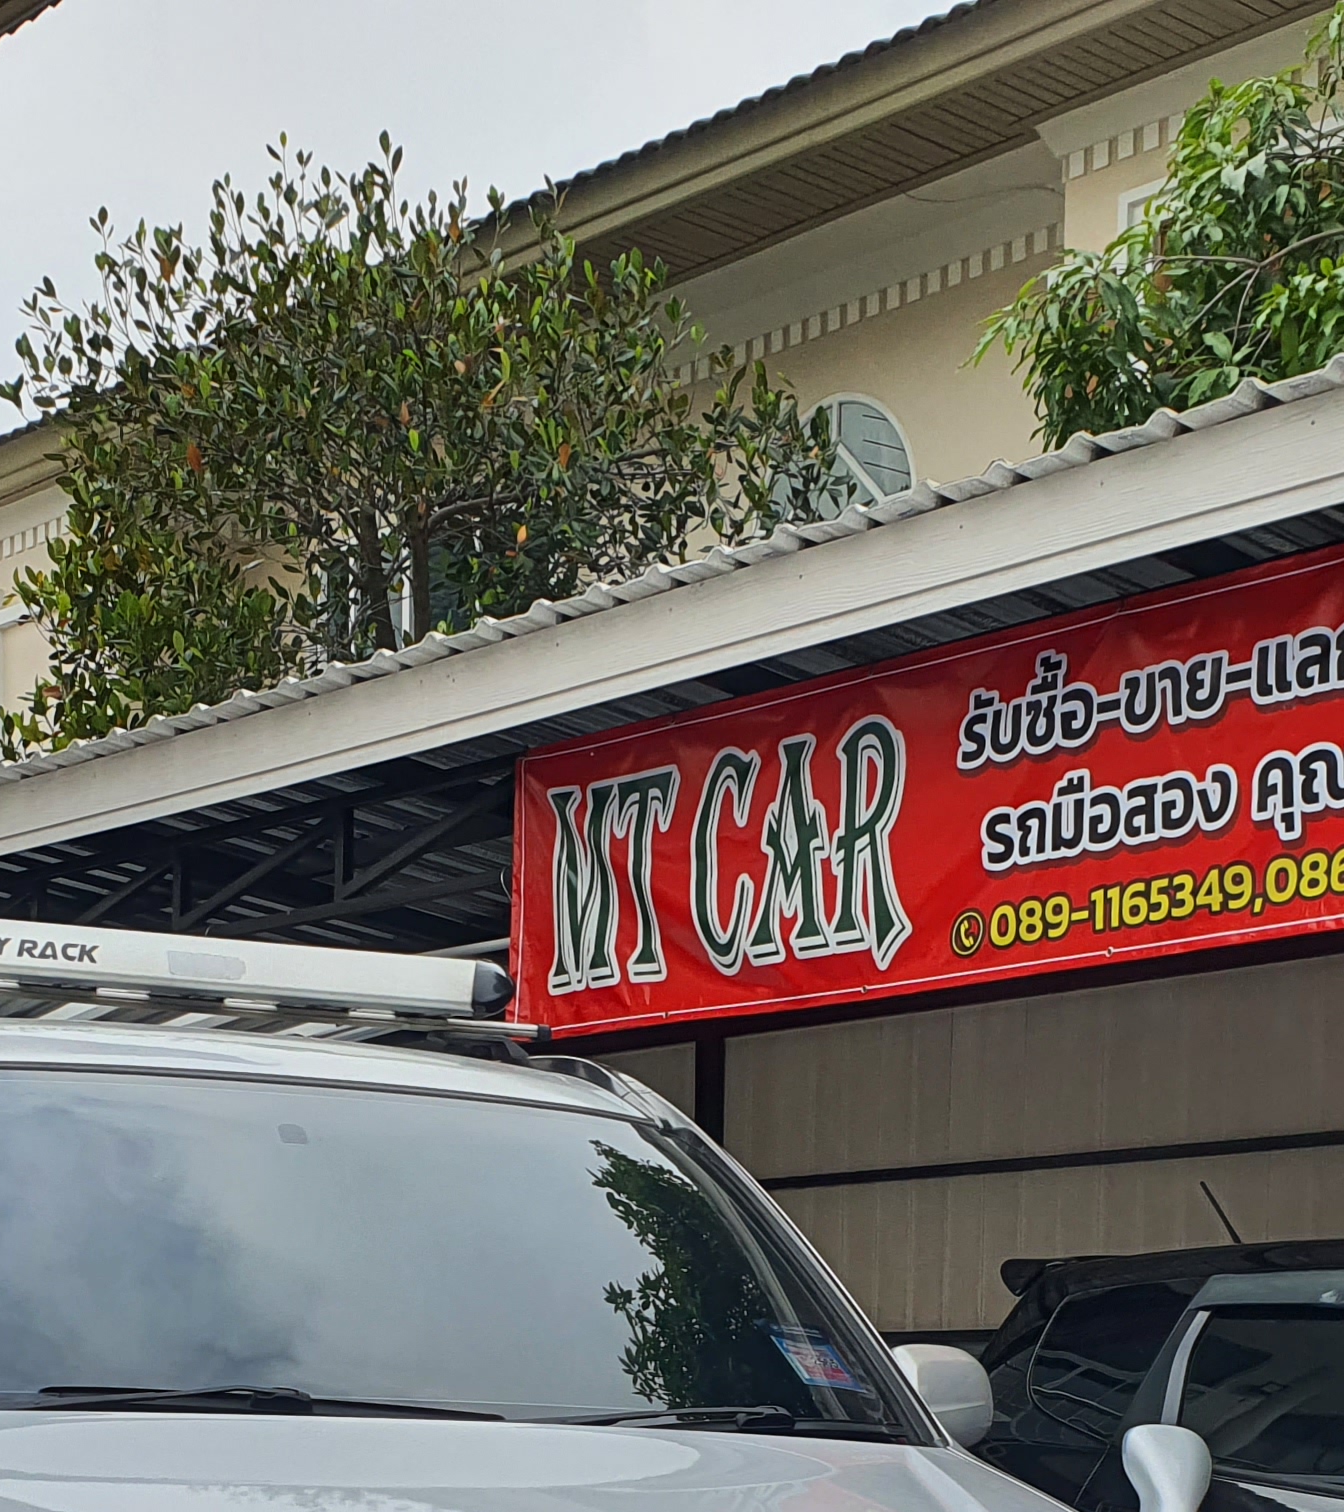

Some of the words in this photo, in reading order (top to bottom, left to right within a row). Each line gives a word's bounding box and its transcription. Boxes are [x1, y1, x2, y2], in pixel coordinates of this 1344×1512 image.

[547, 764, 680, 995] MT
[690, 714, 912, 976] CAR
[981, 763, 1238, 873] รถมือสอง
[17, 938, 100, 964] RACK
